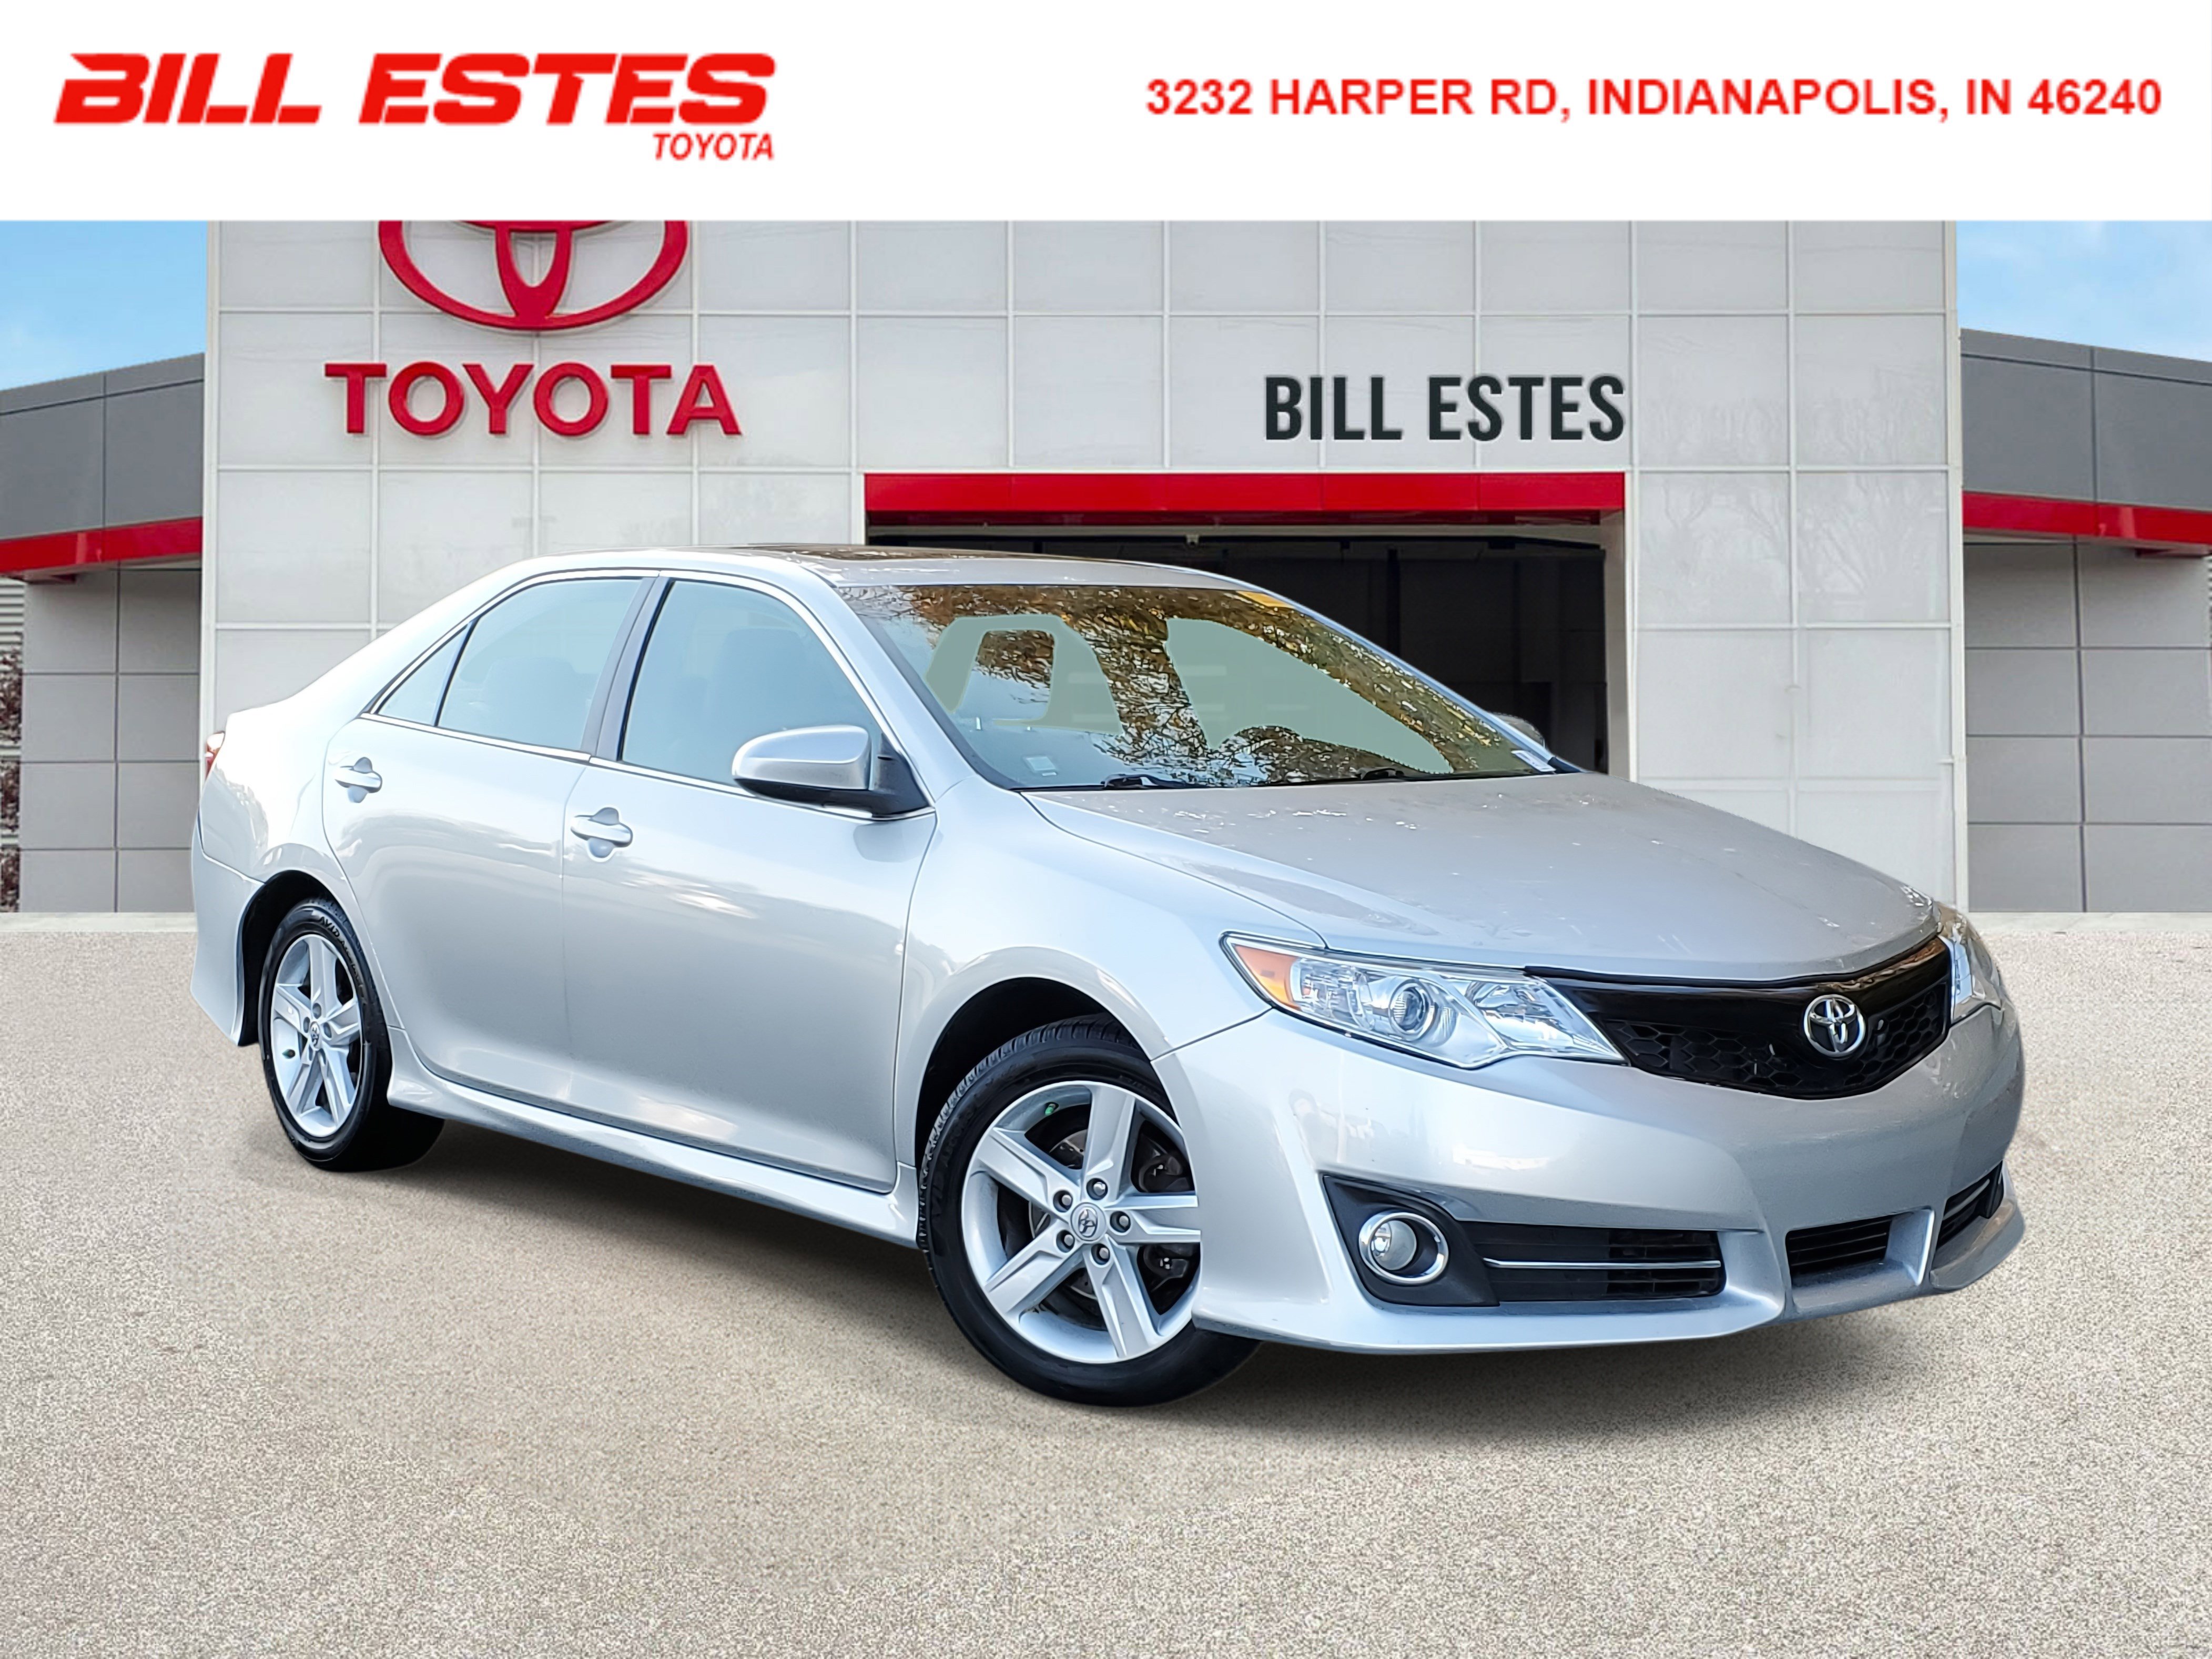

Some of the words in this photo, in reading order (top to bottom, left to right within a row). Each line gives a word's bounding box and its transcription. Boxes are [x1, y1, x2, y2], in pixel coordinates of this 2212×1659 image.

[324, 360, 742, 438] TOYOTA
[1265, 376, 1403, 441] BILL
[1428, 375, 1625, 442] ESTES
